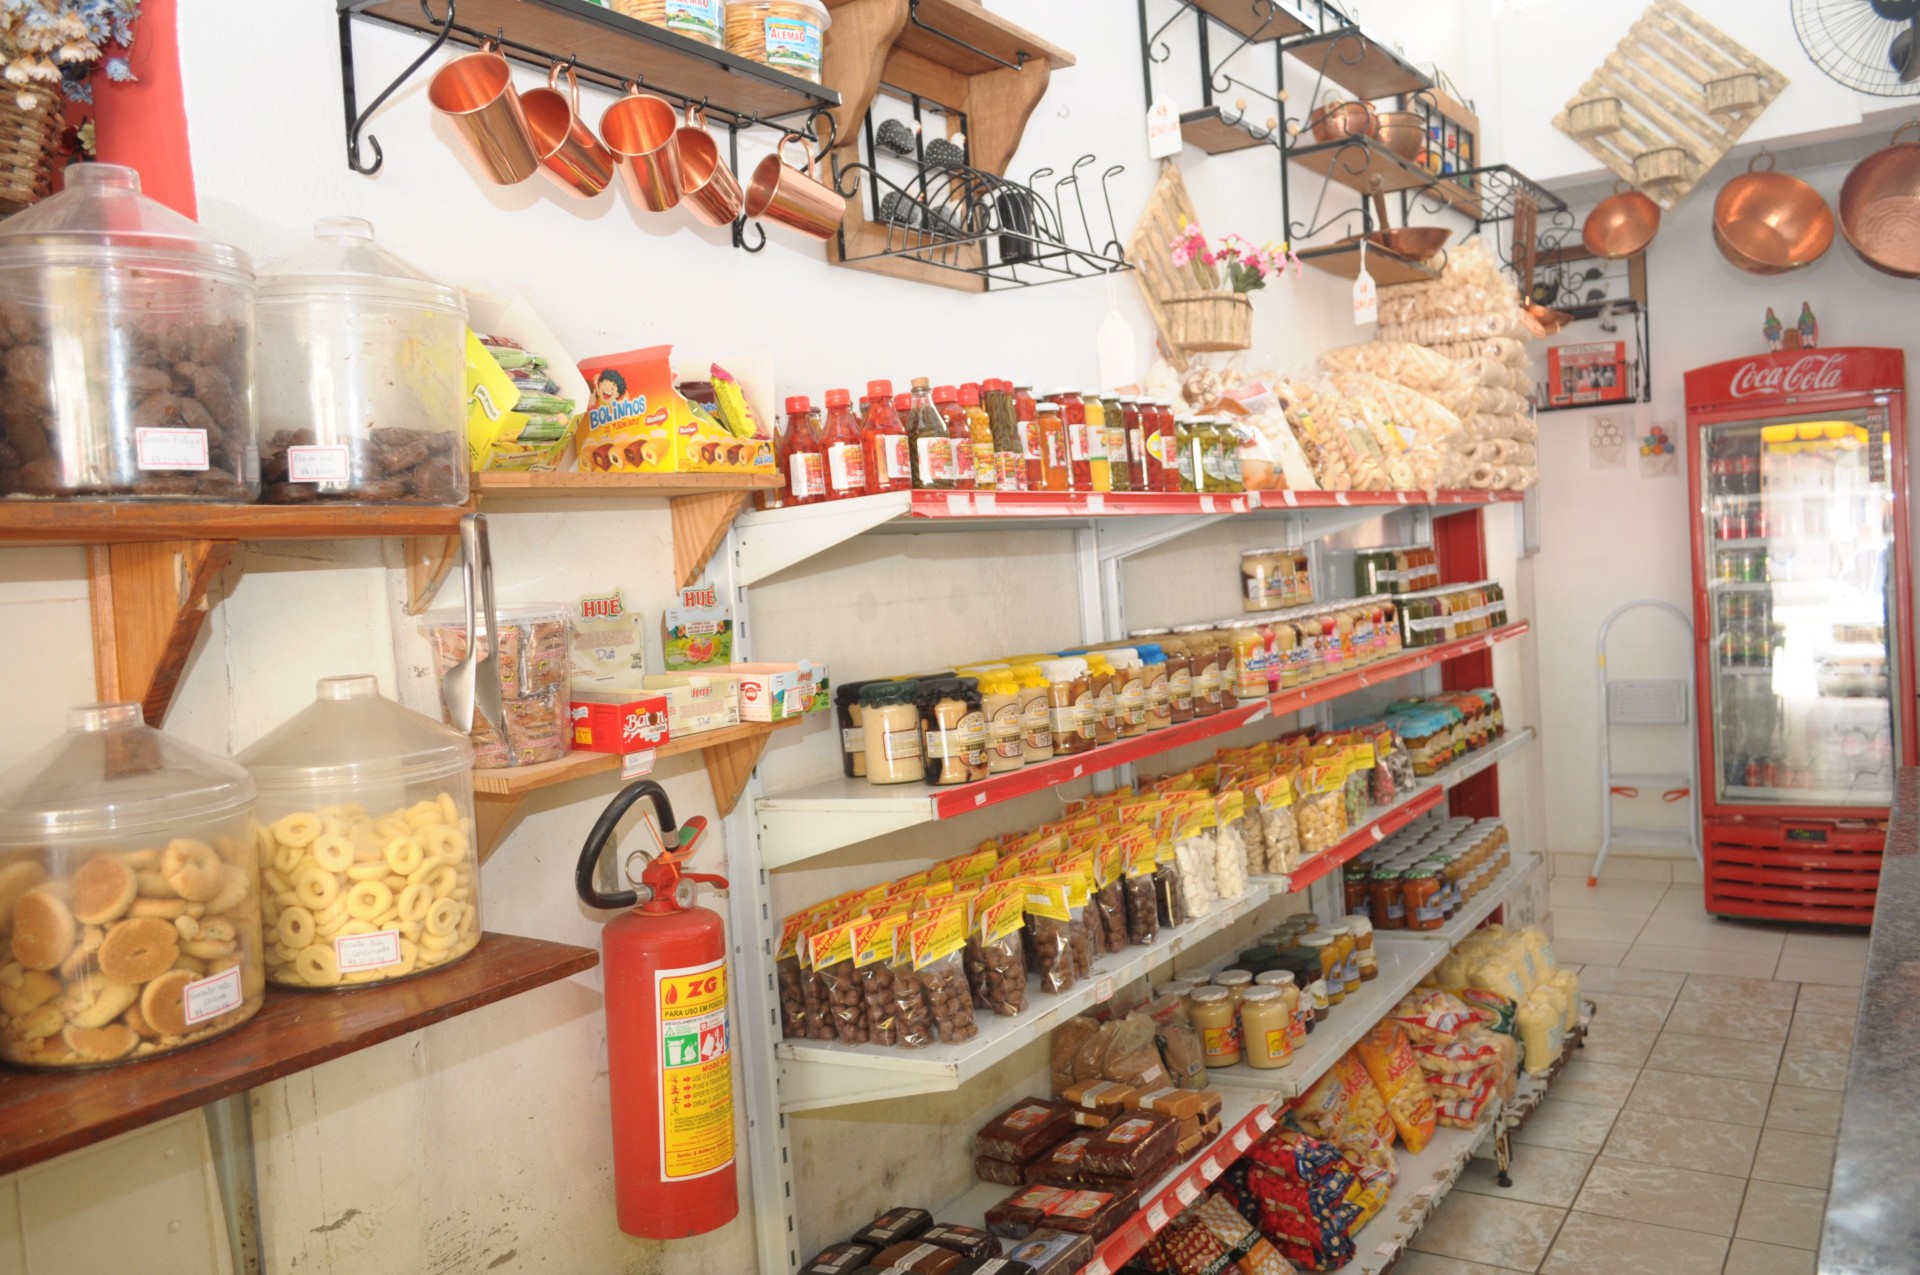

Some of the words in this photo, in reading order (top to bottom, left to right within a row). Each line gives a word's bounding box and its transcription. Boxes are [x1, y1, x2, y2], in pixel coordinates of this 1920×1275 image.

[1730, 353, 1847, 398] Coca-Cola
[687, 976, 718, 998] ZG
[665, 1009, 683, 1017] PARA
[685, 1007, 697, 1016] USO
[699, 1004, 708, 1013] EM
